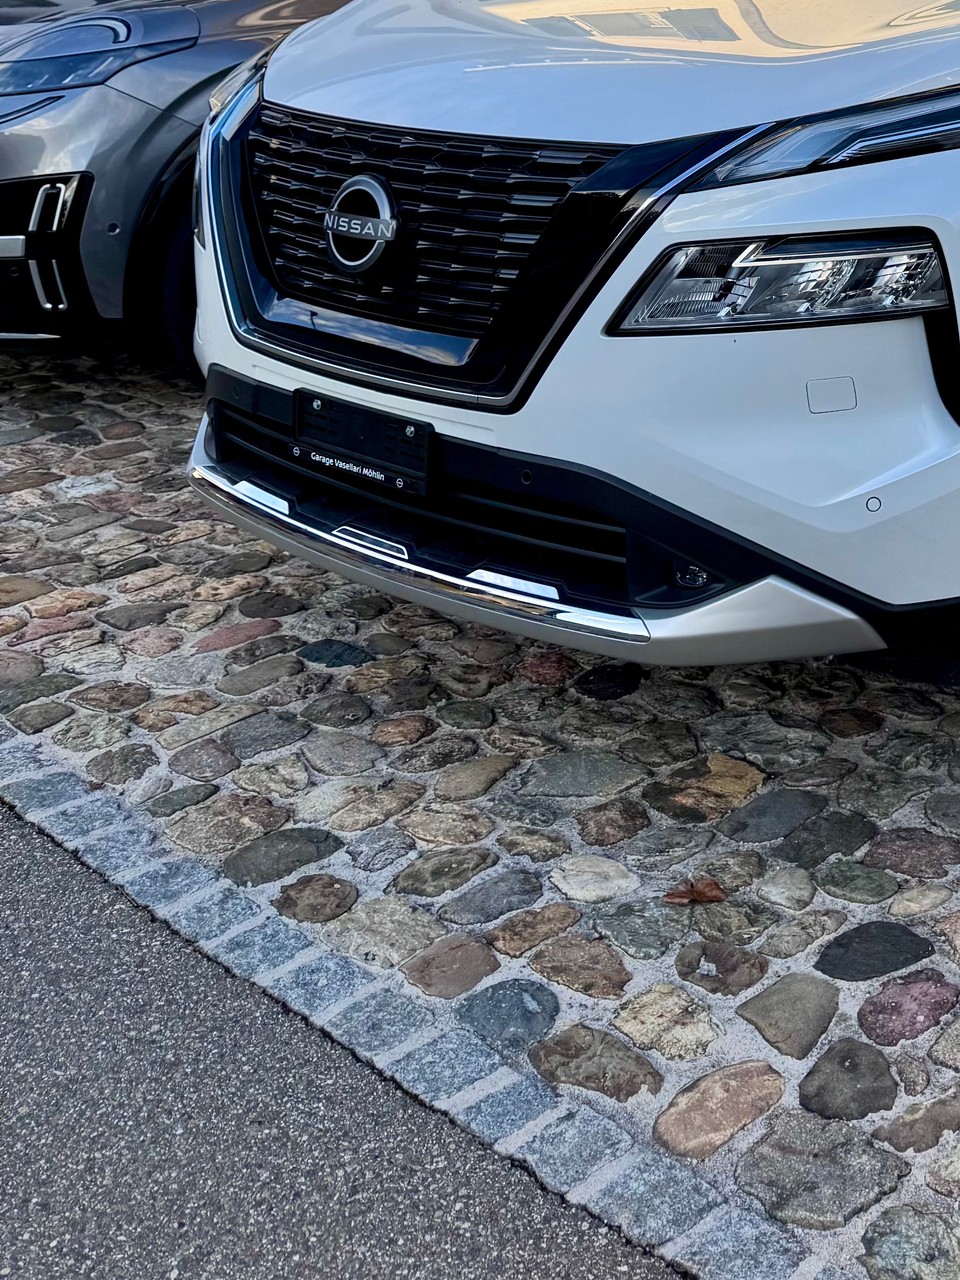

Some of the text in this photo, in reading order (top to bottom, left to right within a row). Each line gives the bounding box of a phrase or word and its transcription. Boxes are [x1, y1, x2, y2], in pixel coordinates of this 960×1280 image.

[323, 213, 395, 238] NISSAN
[310, 451, 385, 481] Garage Vasellari Möhlin
